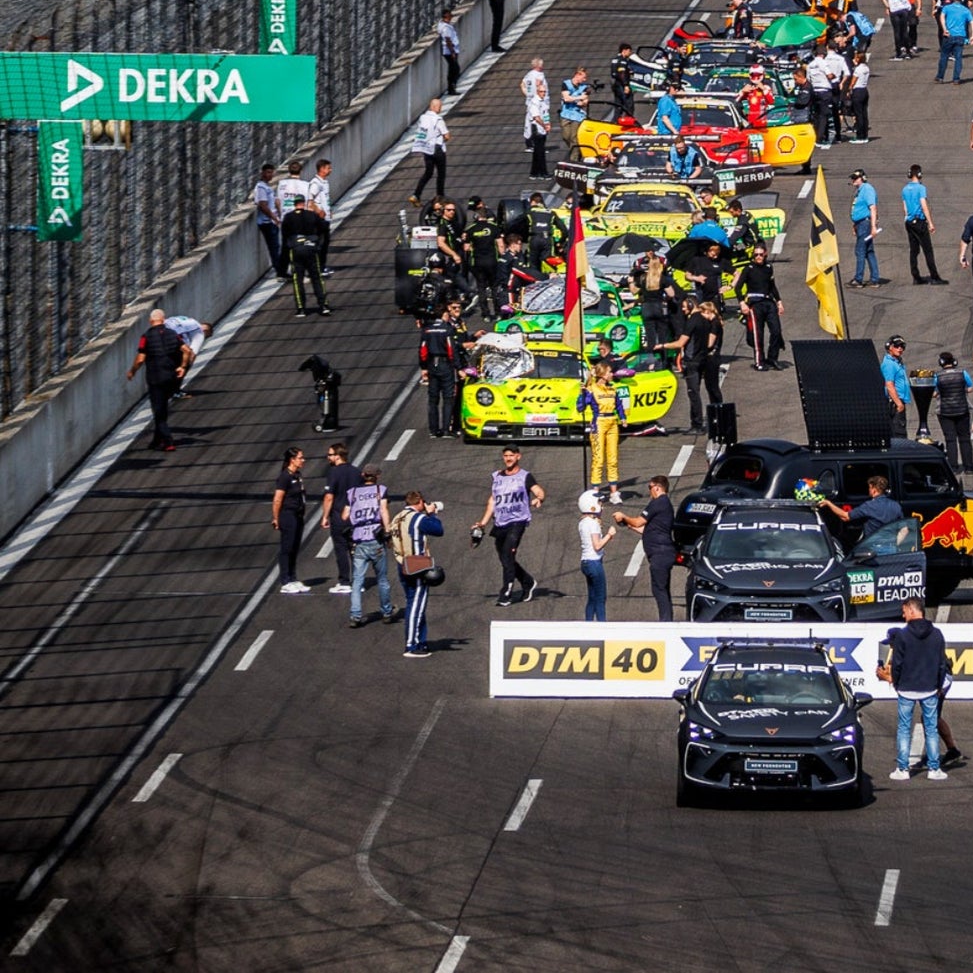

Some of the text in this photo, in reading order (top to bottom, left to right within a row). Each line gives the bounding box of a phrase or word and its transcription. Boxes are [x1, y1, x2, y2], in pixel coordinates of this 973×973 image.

[118, 68, 250, 104] DEKRA
[51, 138, 70, 199] DEKRA
[855, 585, 866, 594] LC
[877, 574, 920, 587] DTM 40
[507, 646, 658, 673] DTM 40
